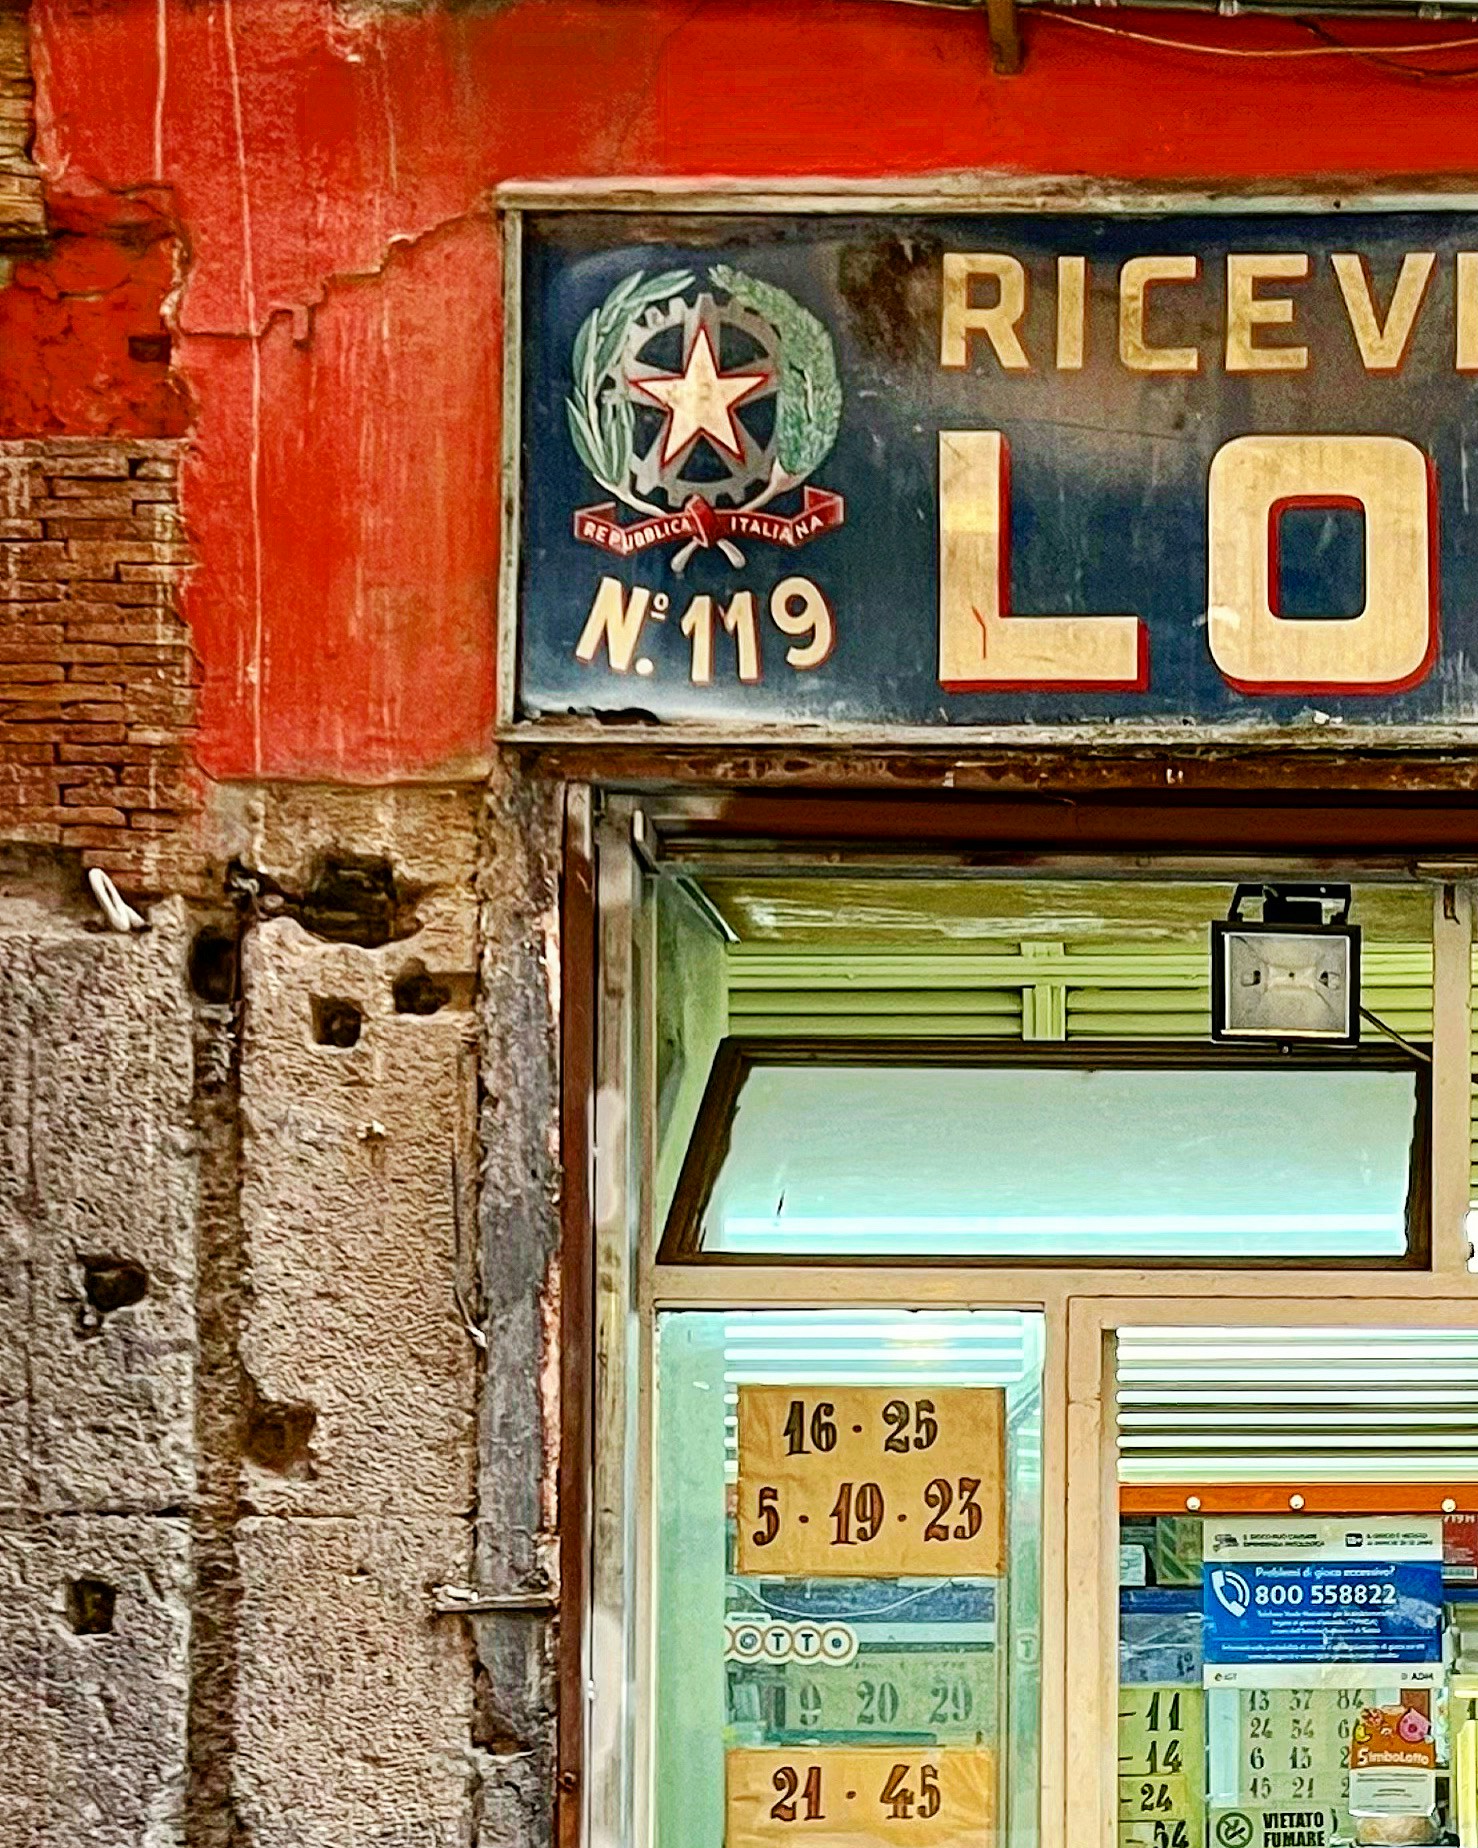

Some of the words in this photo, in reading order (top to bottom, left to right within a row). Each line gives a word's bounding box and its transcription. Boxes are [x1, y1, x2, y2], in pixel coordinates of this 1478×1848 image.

[584, 516, 691, 551] REPUBBLICA
[730, 514, 824, 547] ITALIANA
[680, 576, 837, 686] 119
[783, 1401, 838, 1455] 16
[882, 1399, 938, 1453] 25
[752, 1486, 781, 1547] 5
[830, 1482, 884, 1546] 19
[923, 1477, 983, 1542] 23
[1255, 1584, 1303, 1606] 800
[1310, 1583, 1397, 1605] 558822
[770, 1764, 827, 1822] 21
[880, 1763, 942, 1820] 45
[1262, 1811, 1325, 1830] VIETATO
[1263, 1831, 1326, 1848] FUMARE
